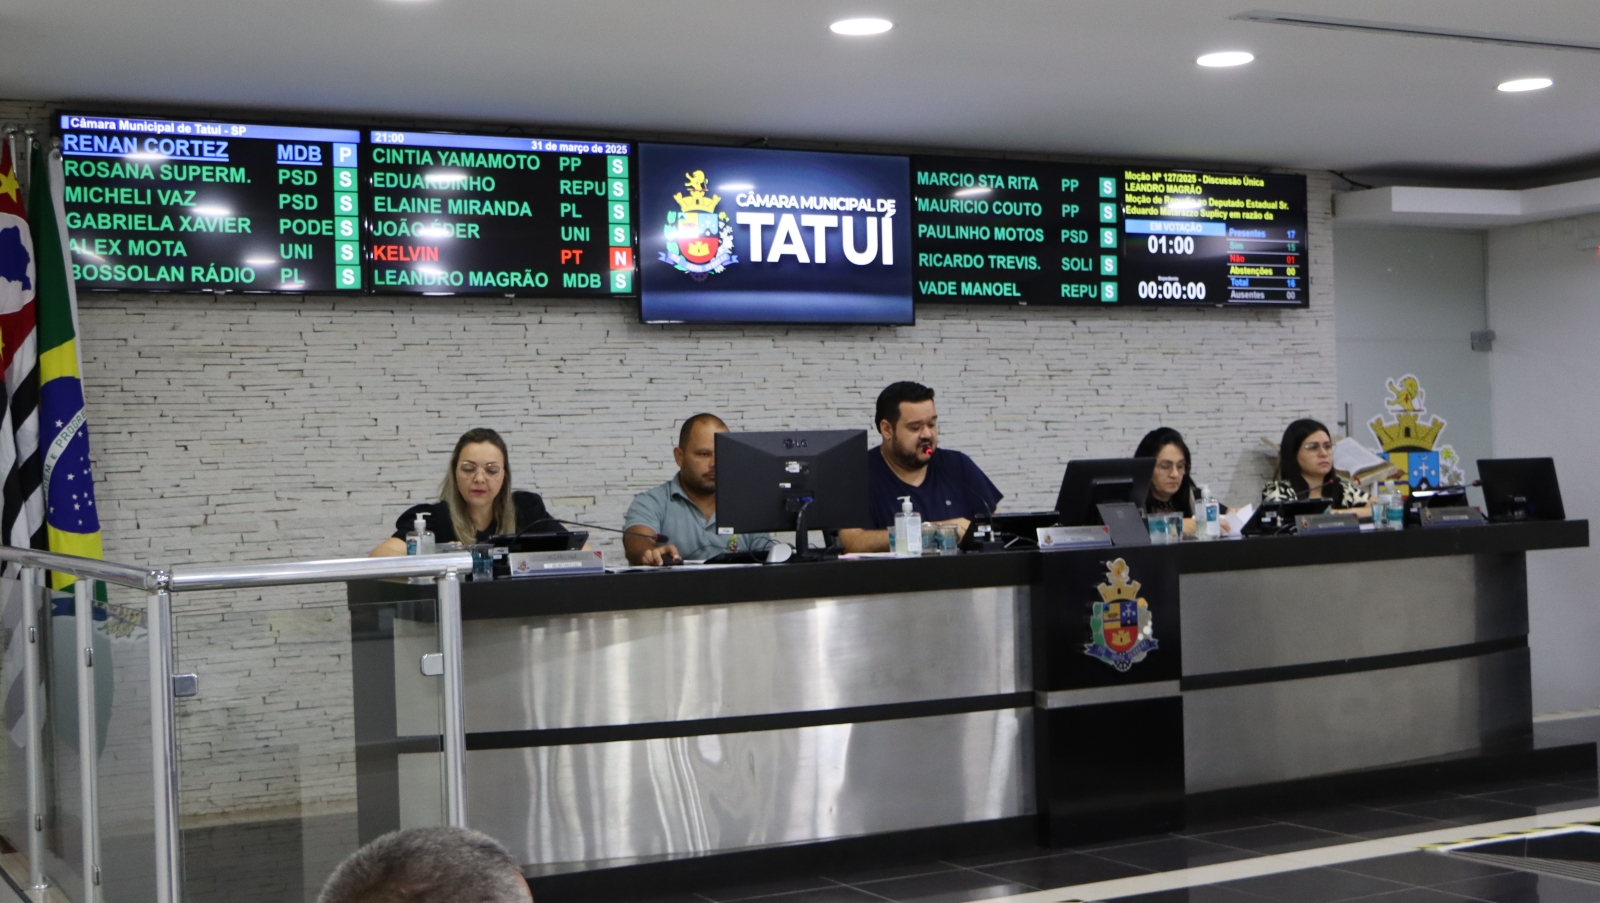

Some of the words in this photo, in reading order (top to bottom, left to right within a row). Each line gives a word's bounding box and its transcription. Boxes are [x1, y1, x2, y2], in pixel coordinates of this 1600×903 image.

[70, 117, 116, 130] Câmara
[119, 120, 174, 134] Municipal
[177, 122, 191, 133] de
[231, 126, 247, 136] SP
[63, 134, 138, 153] RENAN
[144, 138, 229, 158] CORTEZ
[277, 144, 321, 162] MDB
[340, 147, 351, 162] P
[375, 132, 405, 144] 21:00
[531, 141, 543, 151] 31
[545, 142, 558, 151] de
[559, 144, 589, 155] março
[591, 144, 604, 153] de
[605, 144, 628, 154] 2025
[373, 148, 434, 166] CINTIA
[437, 151, 541, 171] YAMAMOTO
[559, 157, 582, 172] PP
[612, 159, 624, 174] S
[64, 160, 154, 180] ROSANA
[160, 164, 251, 183] SUPERM.
[278, 169, 317, 186] PSD
[340, 171, 352, 188] S
[917, 171, 974, 187] MARCIO
[978, 174, 1005, 189] STA
[1008, 176, 1039, 191] RITA
[1061, 179, 1079, 192] PP
[1103, 180, 1112, 194] S
[1125, 171, 1151, 182] Moção
[1202, 174, 1242, 186] Discussão
[1243, 175, 1265, 187] Única
[373, 172, 496, 192] EDUARDINHO
[559, 180, 606, 196] REPU
[612, 181, 624, 197] S
[1125, 182, 1165, 193] LEANDRO
[1166, 184, 1202, 195] MAGRÃO
[65, 186, 151, 205] MICHELI
[158, 189, 196, 207] VAZ
[278, 194, 318, 210] PSD
[340, 195, 352, 212] S
[374, 196, 442, 214] ELAINE
[448, 199, 533, 217] MIRANDA
[560, 203, 582, 218] PL
[613, 204, 625, 220] S
[736, 191, 800, 209] CÂMARA
[800, 196, 876, 212] MUNICIPAL
[877, 199, 896, 213] DE
[917, 198, 989, 214] MAURICIO
[992, 201, 1042, 217] COUTO
[1061, 204, 1079, 218] PP
[1103, 205, 1113, 219] S
[1125, 194, 1151, 205] Moção
[1153, 195, 1163, 204] de
[1208, 197, 1245, 209] Deputado
[1245, 199, 1278, 210] Estadual
[1126, 205, 1159, 215] Eduardo
[1200, 208, 1228, 220] Suplicy
[1229, 211, 1241, 219] em
[1264, 211, 1274, 220] da
[66, 212, 174, 232] GABRIELA
[179, 215, 252, 234] XAVIER
[279, 219, 334, 236] PODE
[340, 220, 353, 237] S
[373, 218, 425, 238] JOÃO
[431, 219, 480, 239] ÉDER
[561, 227, 590, 242] UNI
[614, 228, 625, 243] S
[918, 224, 990, 240] PAULINHO
[994, 227, 1045, 242] MOTOS
[1061, 230, 1088, 244] PSD
[1104, 231, 1113, 245] S
[1150, 222, 1162, 231] EM
[1164, 221, 1203, 233] VOTAÇÃO
[1229, 227, 1266, 238] Presentes
[1287, 230, 1296, 239] 17
[736, 211, 896, 266] TATUÍ
[1147, 235, 1195, 255] 01:00
[1229, 241, 1244, 250] Sim
[1287, 243, 1296, 251] 15
[69, 238, 122, 255] ALEX
[128, 240, 187, 257] MOTA
[280, 244, 313, 259] UNI
[341, 244, 353, 261] S
[373, 245, 439, 262] KELVIN
[561, 250, 583, 265] PT
[615, 252, 627, 266] N
[1229, 254, 1245, 263] Não
[1286, 255, 1295, 264] 01
[918, 253, 984, 269] RICARDO
[988, 255, 1041, 270] TREVIS.
[1061, 257, 1092, 271] SOLI
[1104, 258, 1114, 272] S
[1229, 265, 1273, 277] Abstenções
[1286, 267, 1296, 276] 00
[72, 264, 184, 283] BOSSOLAN
[191, 263, 256, 284] RÁDIO
[280, 268, 305, 284] PL
[342, 269, 355, 286] S
[374, 269, 464, 287] LEANDRO
[469, 269, 549, 289] MAGRÃO
[563, 274, 602, 289] MDB
[615, 274, 627, 289] S
[1230, 277, 1250, 287] Total
[1287, 279, 1296, 288] 16
[919, 281, 957, 295] VADE
[961, 282, 1021, 297] MANOEL
[1061, 284, 1098, 298] REPU
[1105, 285, 1114, 299] S
[1138, 280, 1206, 300] 00:00:00
[1230, 290, 1265, 299] Ausentes
[1286, 291, 1296, 300] 00
